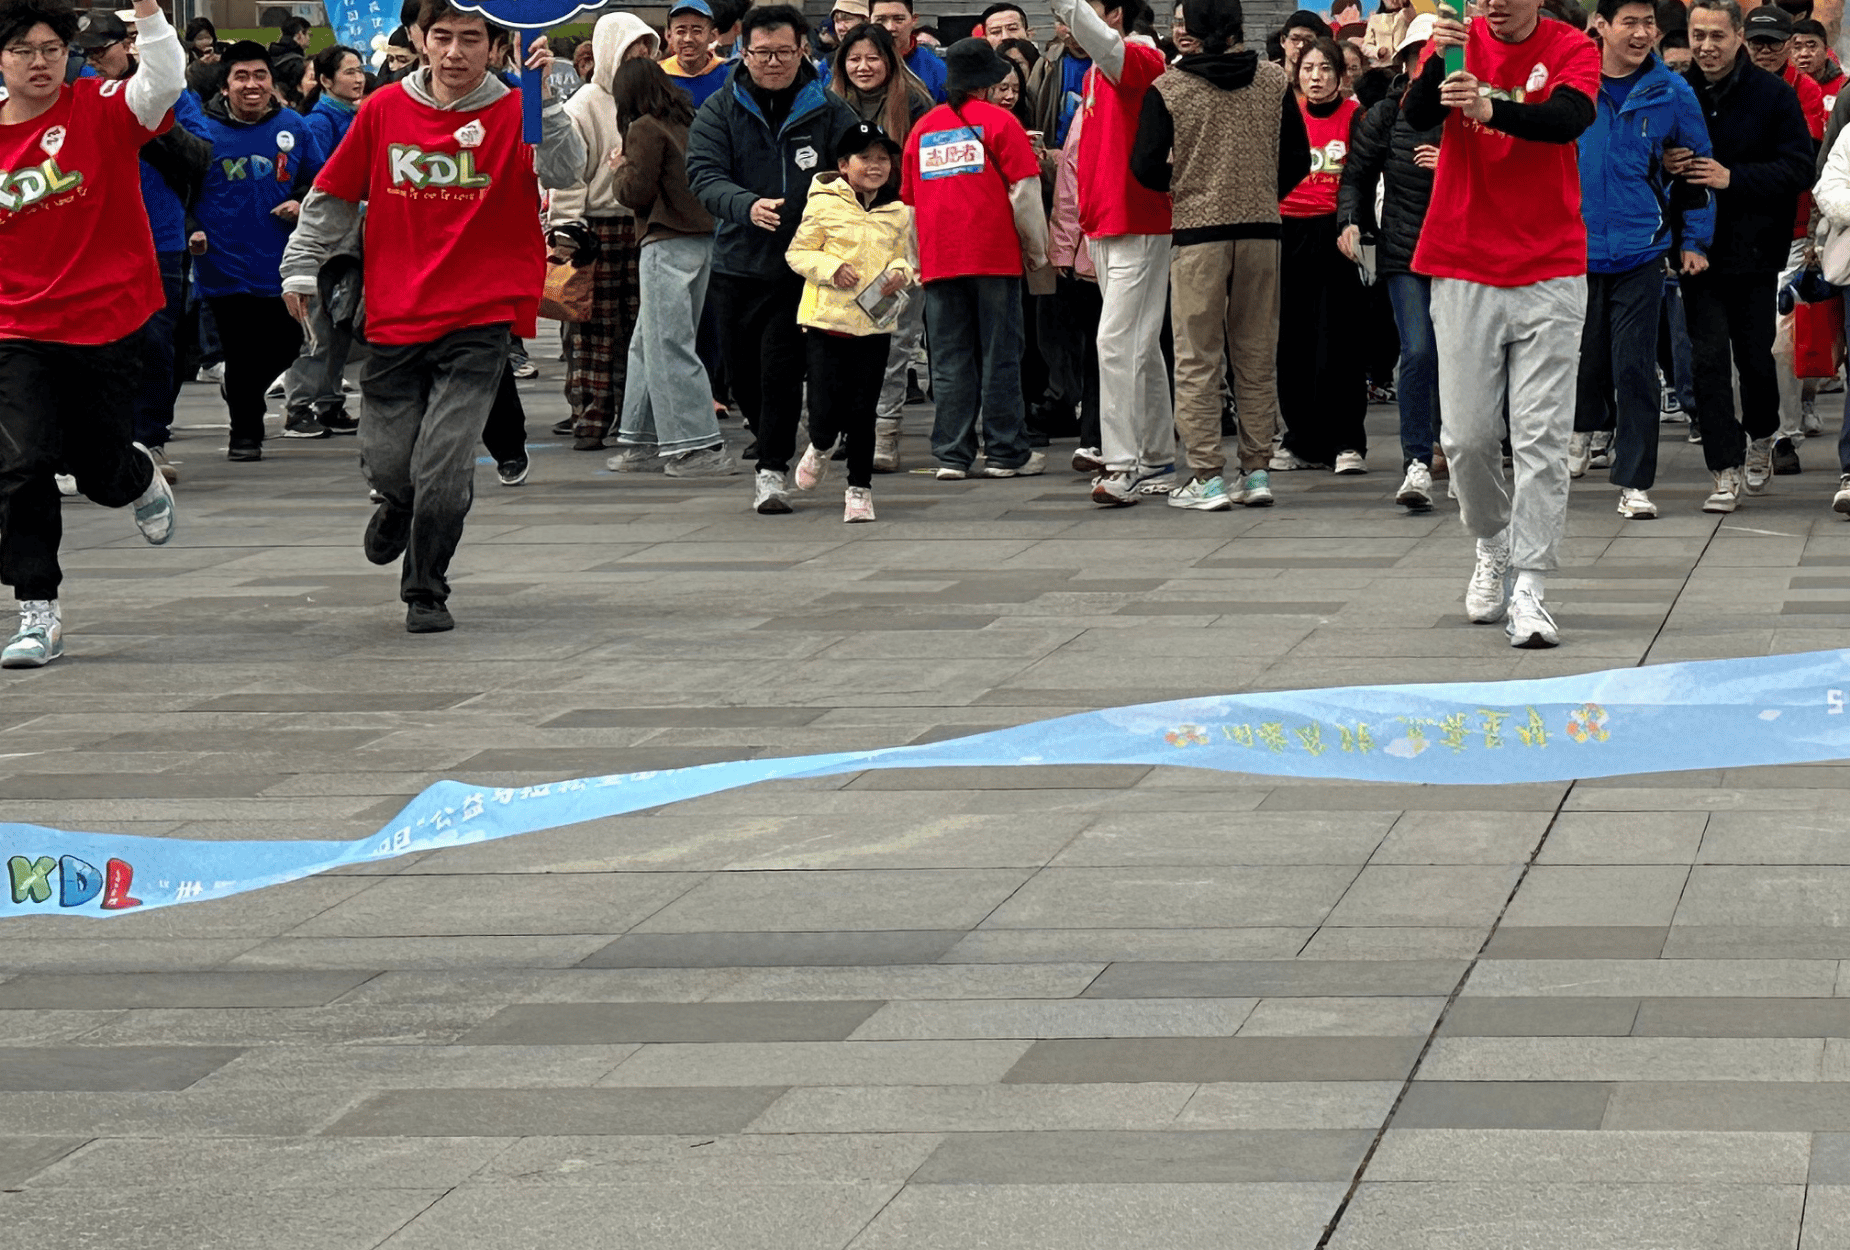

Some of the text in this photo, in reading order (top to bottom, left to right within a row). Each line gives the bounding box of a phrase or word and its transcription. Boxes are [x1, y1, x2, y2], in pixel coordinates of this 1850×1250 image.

[222, 152, 291, 182] KDL
[388, 143, 491, 188] KDL
[7, 855, 143, 910] KDL
